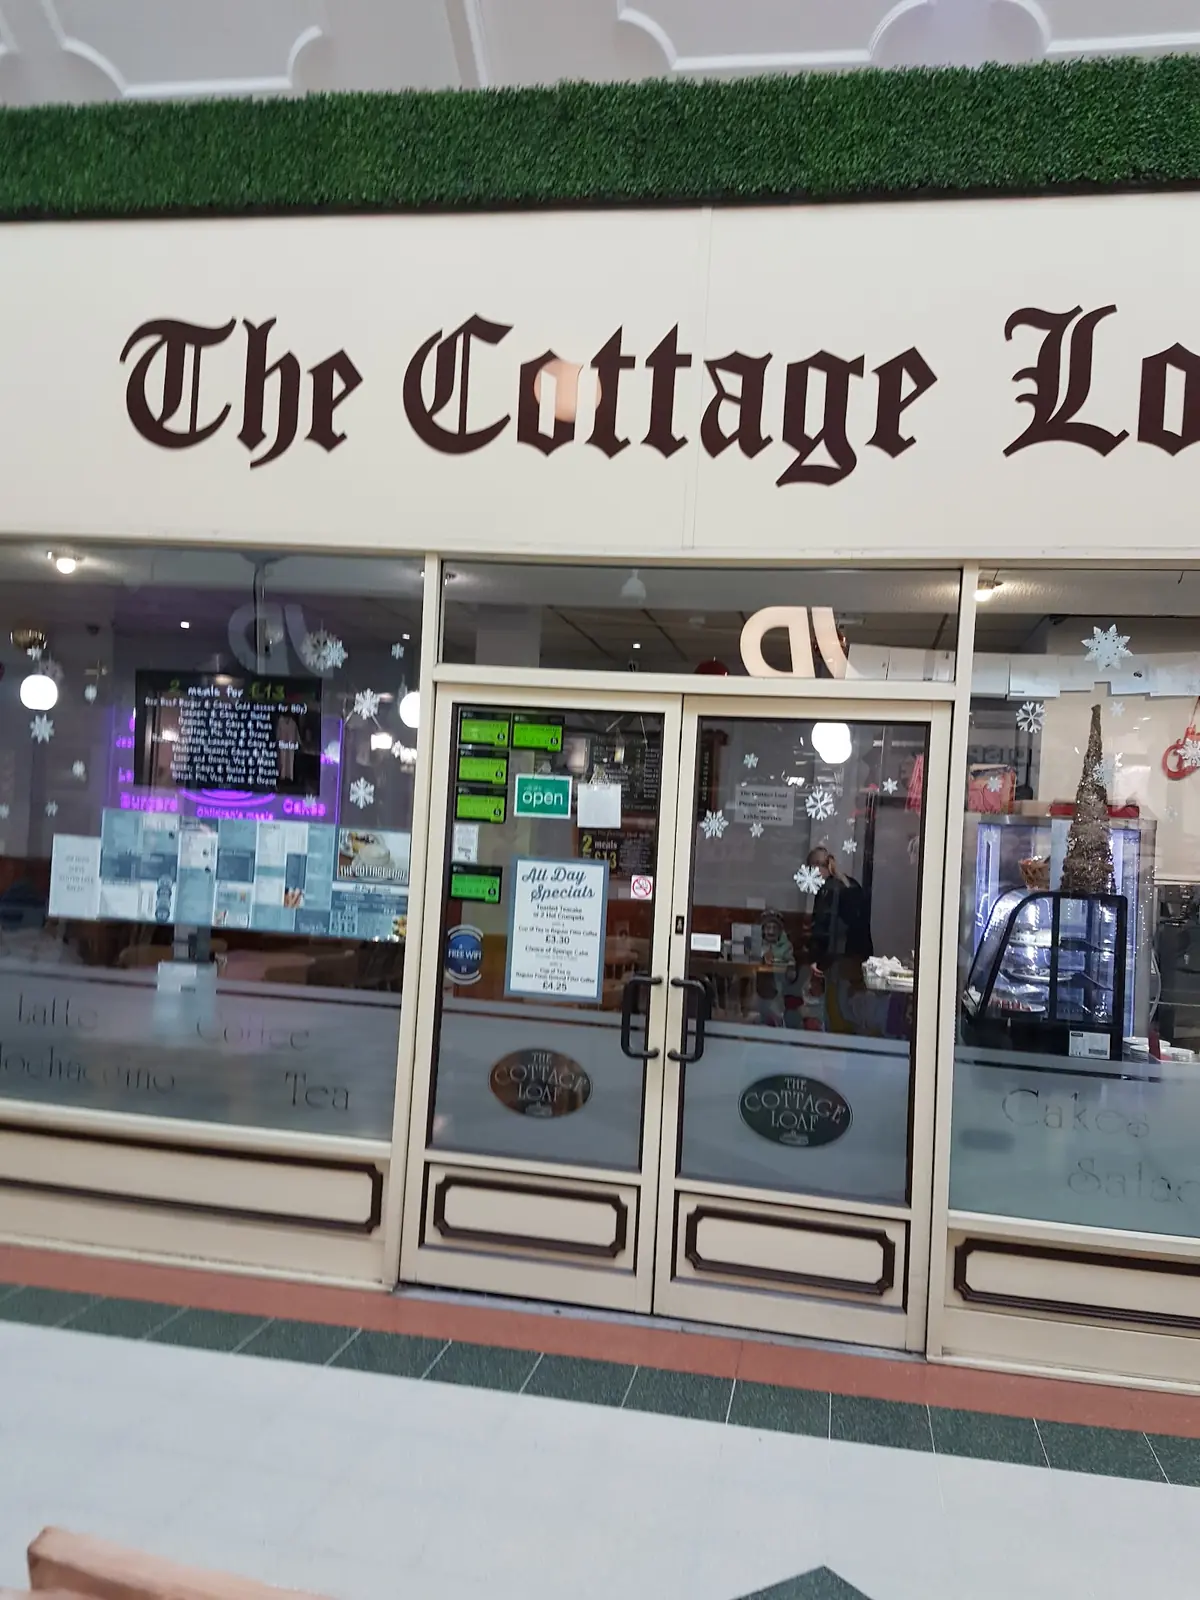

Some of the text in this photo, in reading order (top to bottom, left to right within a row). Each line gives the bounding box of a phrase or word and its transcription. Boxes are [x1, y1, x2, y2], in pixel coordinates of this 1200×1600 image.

[120, 305, 1200, 487] The Cottage Lo
[188, 685, 221, 698] meals
[227, 685, 244, 698] for
[213, 700, 233, 711] Chips
[219, 709, 239, 720] Chips
[250, 711, 271, 721] Salad
[225, 719, 245, 730] Chips
[256, 721, 273, 730] Peas
[230, 747, 250, 757] Chips
[261, 748, 278, 758] Peas
[247, 738, 267, 749] Chips
[278, 740, 299, 750] Salad
[283, 797, 326, 816] Cakes
[522, 791, 563, 808] open
[583, 835, 618, 855] 2 meals
[522, 866, 586, 886] All Day
[531, 884, 596, 903] Specials
[557, 914, 585, 922] Crumpets
[545, 935, 570, 944] £3.30
[448, 948, 465, 959] FREE
[542, 981, 567, 991] £4.25
[196, 1013, 310, 1051] Coffee
[532, 1052, 553, 1065] THE
[0, 1042, 175, 1095] ochaccino
[494, 1063, 587, 1092] COTTAGE
[284, 1071, 349, 1111] Tea
[517, 1082, 560, 1103] LOAF
[784, 1077, 807, 1092] THE
[744, 1089, 847, 1125] COTTAGE
[1001, 1088, 1150, 1139] Cakes
[771, 1110, 819, 1132] LOAF
